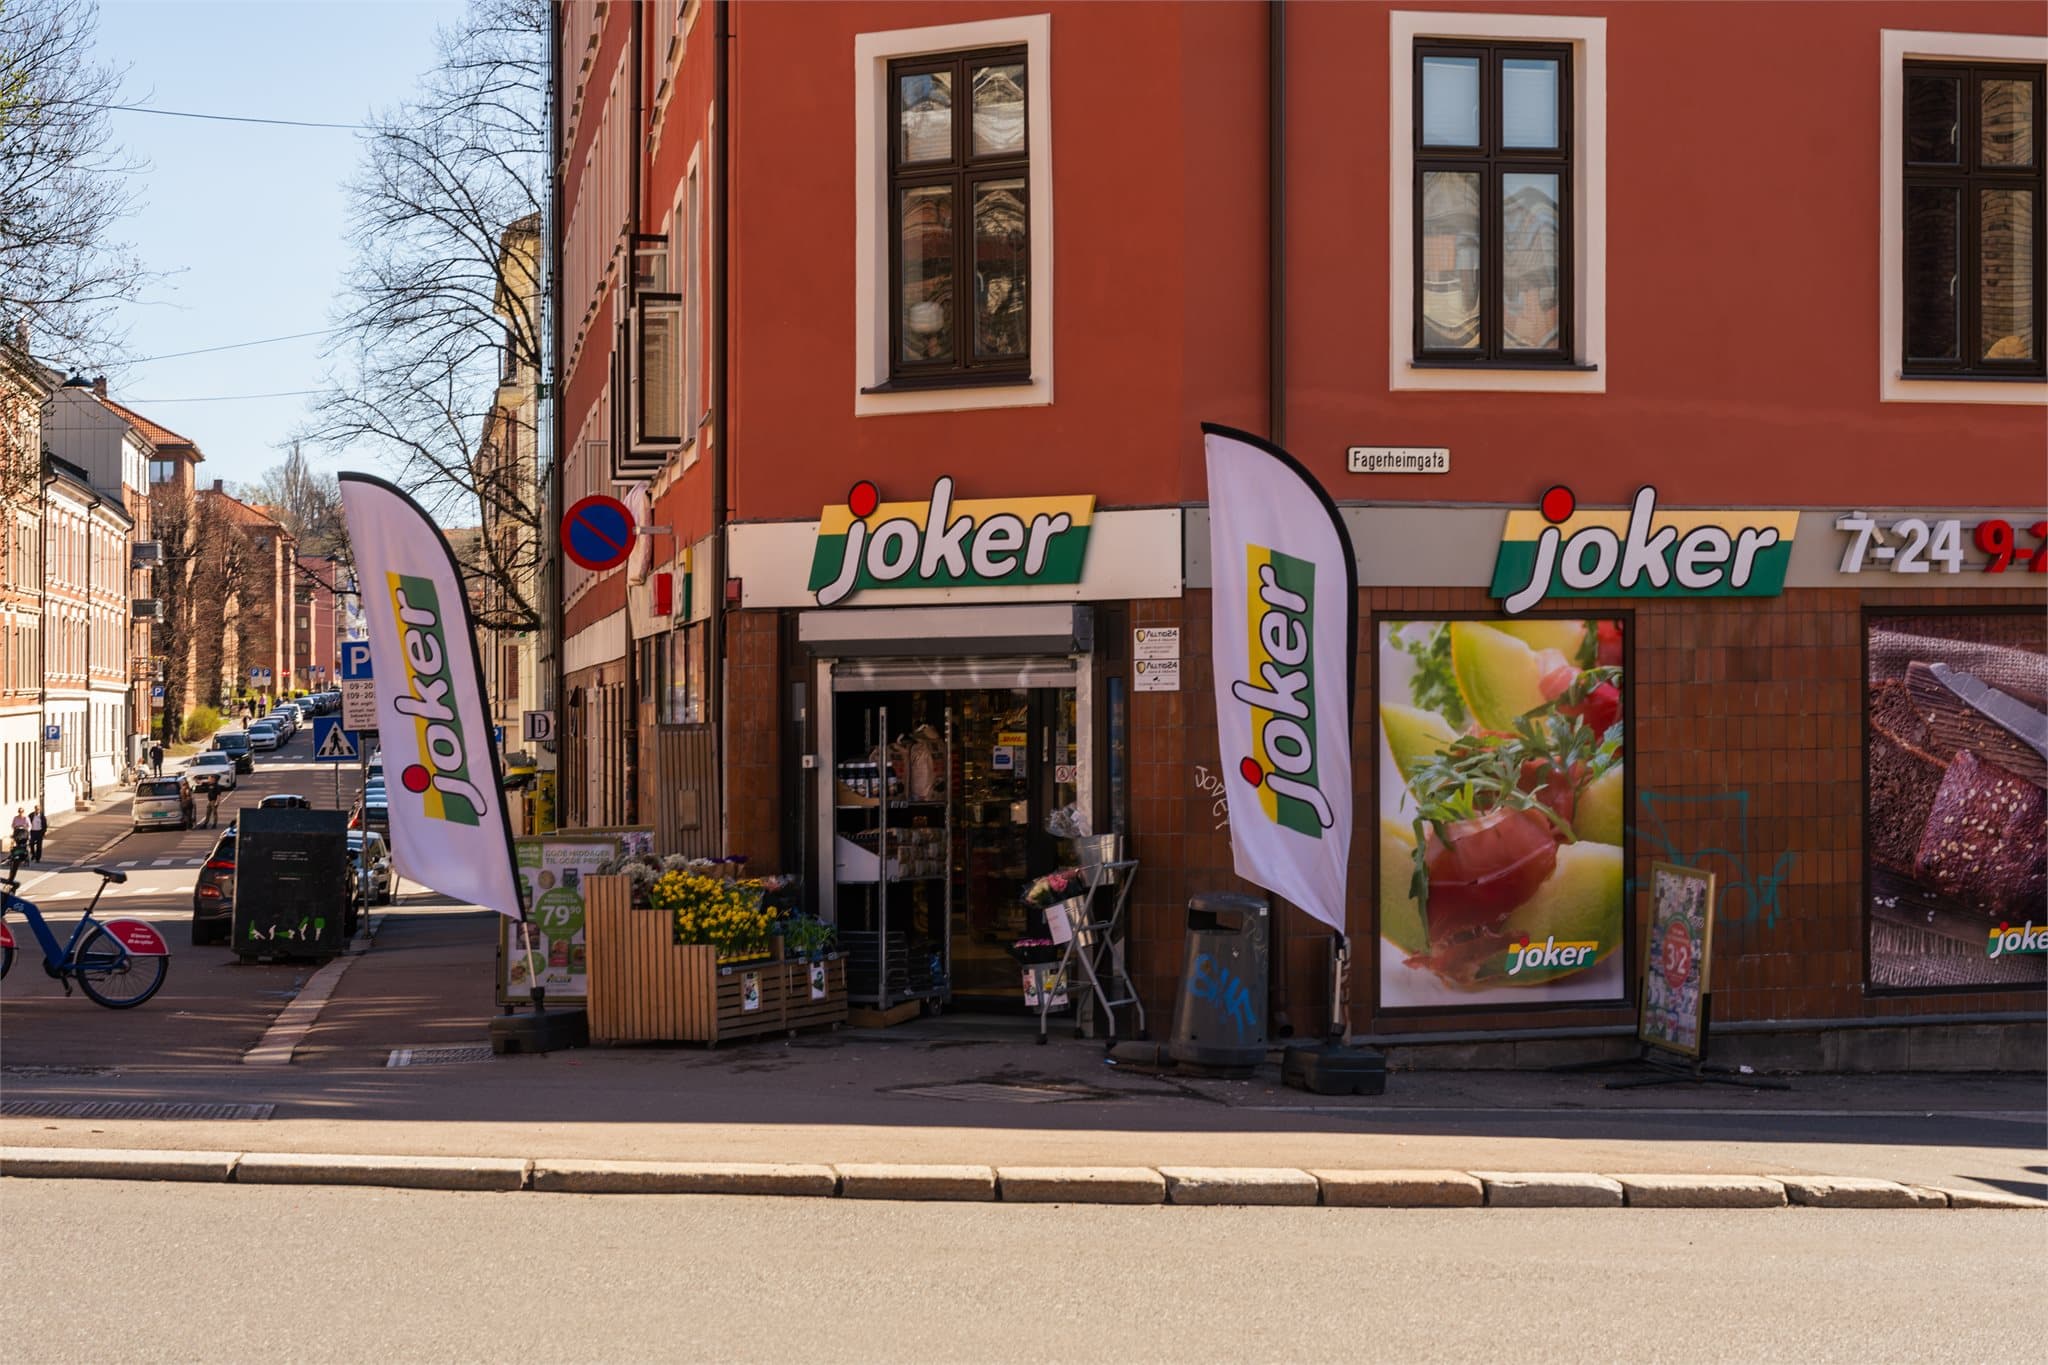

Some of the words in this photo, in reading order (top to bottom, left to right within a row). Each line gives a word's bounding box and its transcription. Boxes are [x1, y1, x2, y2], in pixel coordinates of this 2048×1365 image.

[1353, 450, 1444, 471] Fagerheimgata
[816, 475, 1072, 607] joker
[1504, 485, 1779, 615] joker
[1836, 515, 1964, 573] 7-24
[351, 646, 371, 675] P
[394, 587, 488, 816] joker
[1232, 564, 1334, 829] joker
[49, 727, 57, 738] P
[1508, 935, 1592, 976] joker
